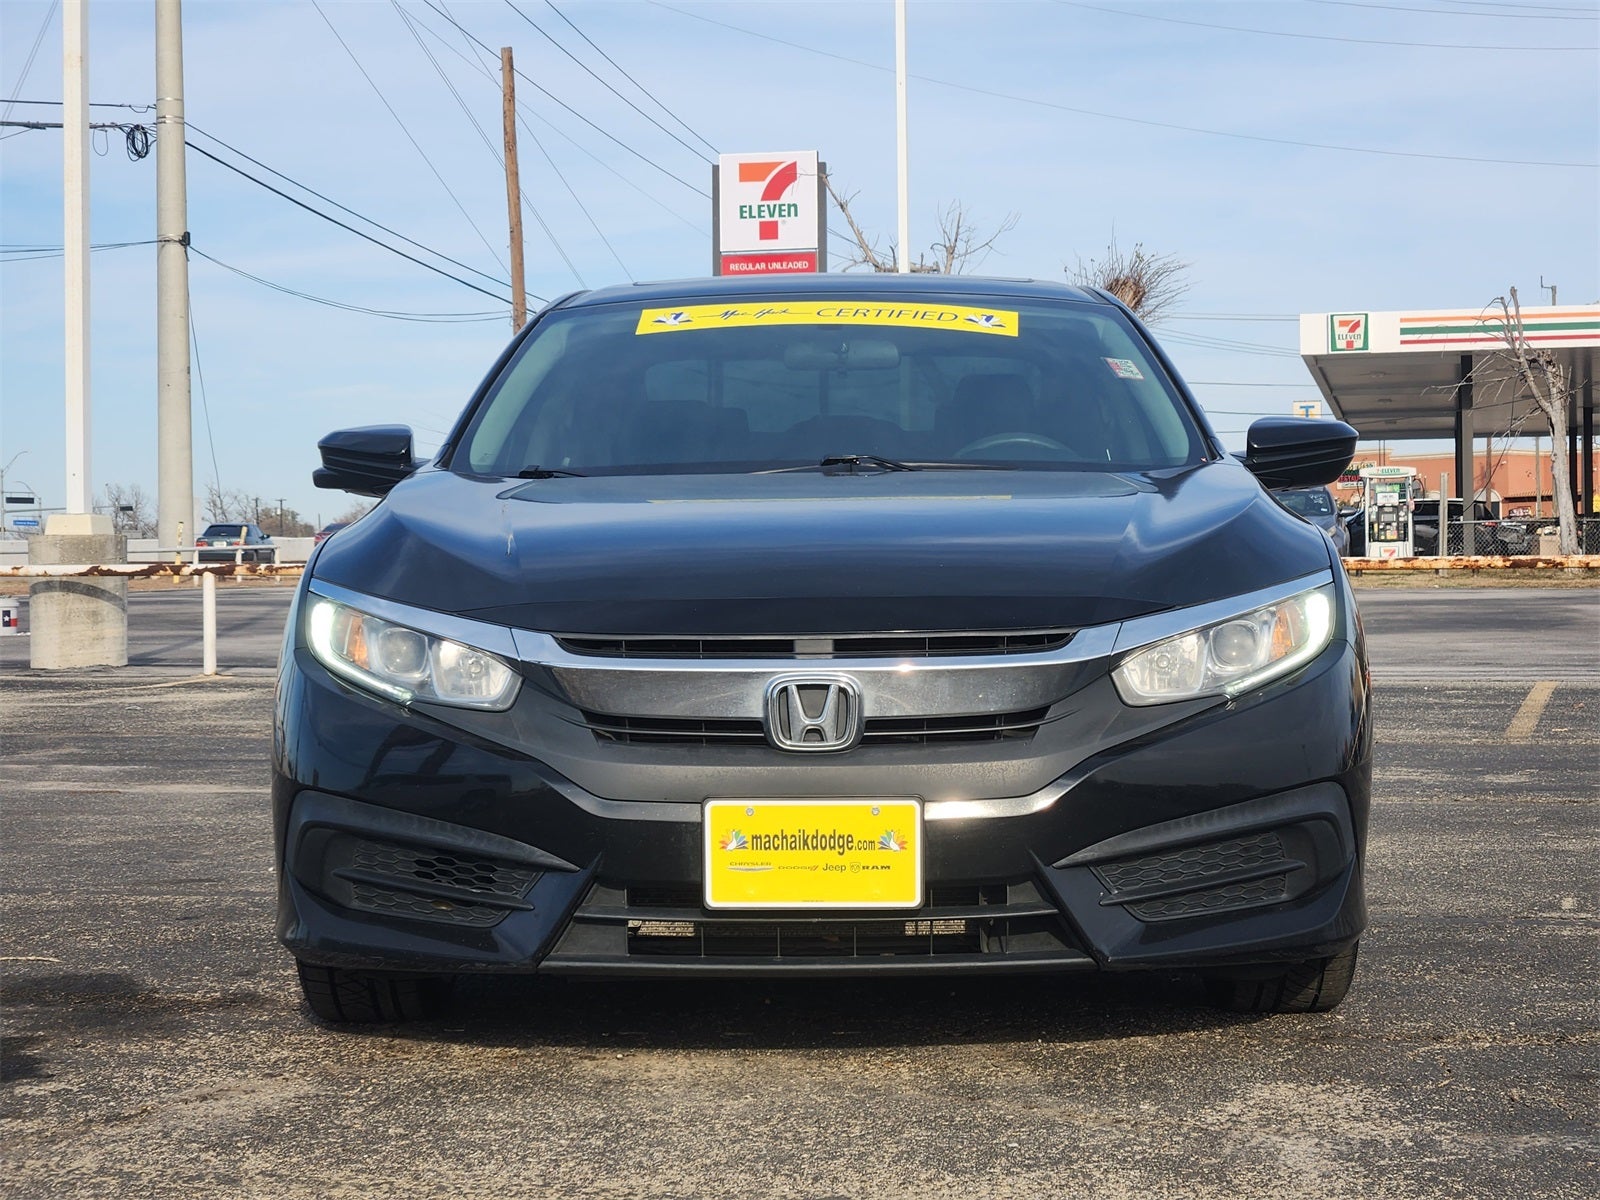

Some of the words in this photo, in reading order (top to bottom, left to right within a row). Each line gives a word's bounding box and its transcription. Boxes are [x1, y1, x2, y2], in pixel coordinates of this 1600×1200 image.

[729, 261, 766, 271] REGULAR
[768, 260, 809, 270] UNLEADED
[816, 307, 959, 322] CERTIFIED
[751, 829, 876, 856] machaikdodge.com
[822, 863, 847, 873] Jeep
